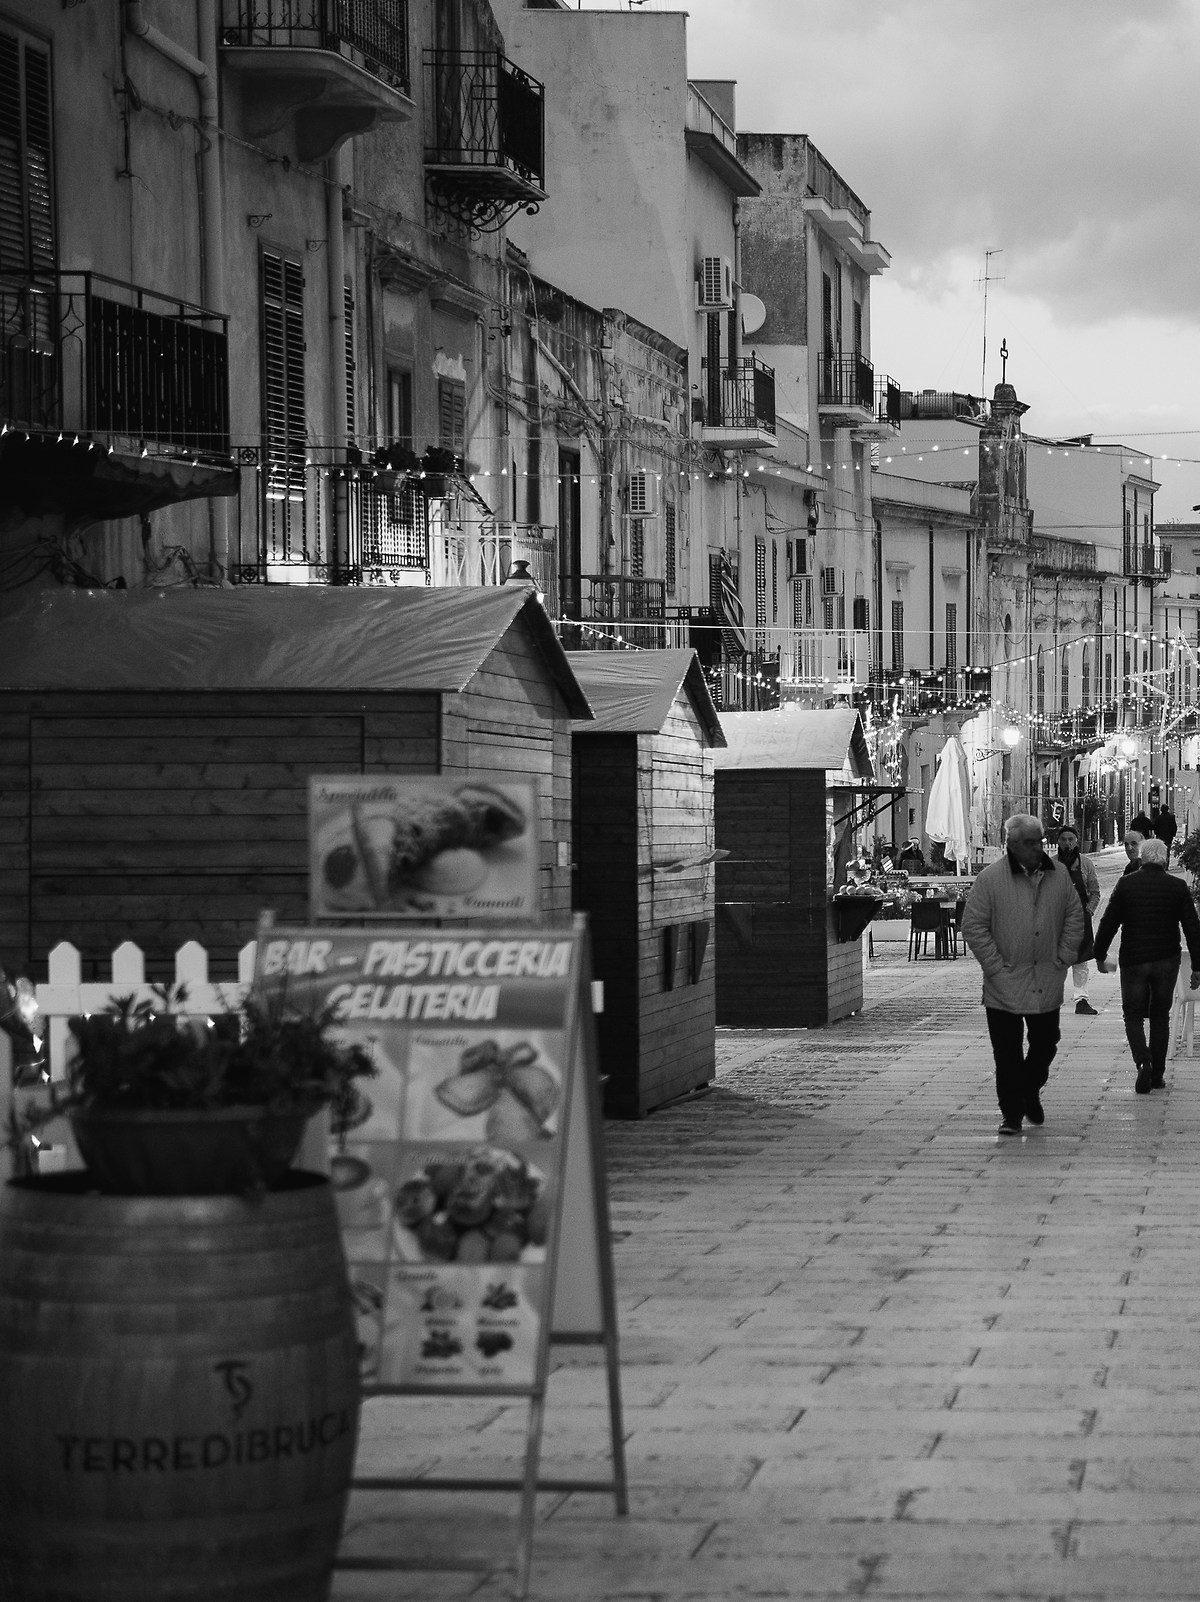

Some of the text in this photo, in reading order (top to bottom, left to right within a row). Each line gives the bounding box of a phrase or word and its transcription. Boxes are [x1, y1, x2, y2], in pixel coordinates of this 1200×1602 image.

[262, 940, 334, 976] BAR
[361, 940, 575, 977] PASTICCERIA
[325, 983, 502, 1021] GELATERIA
